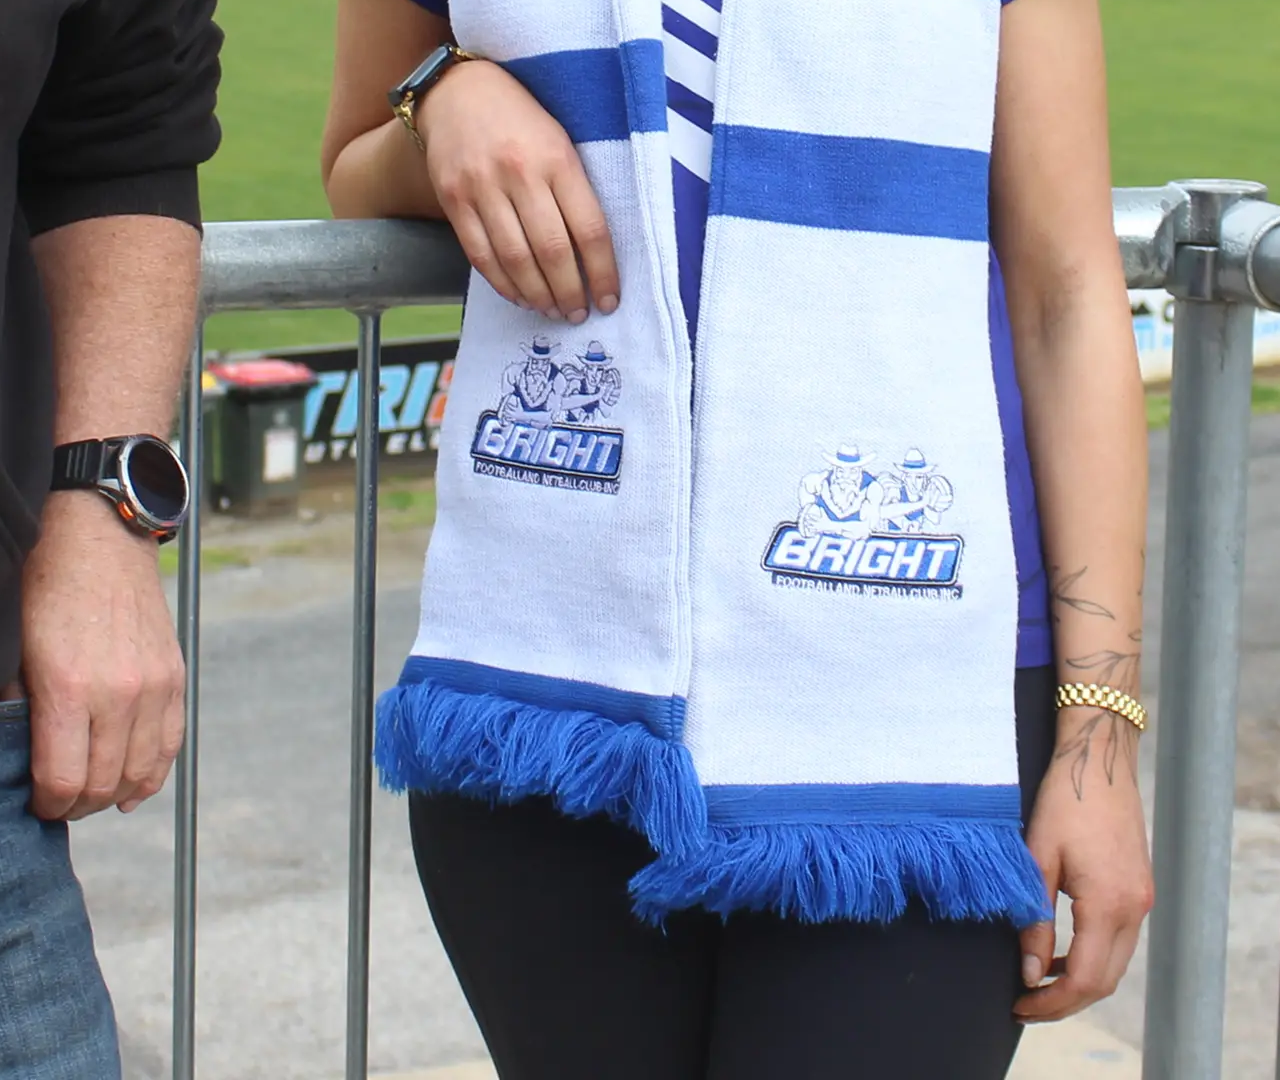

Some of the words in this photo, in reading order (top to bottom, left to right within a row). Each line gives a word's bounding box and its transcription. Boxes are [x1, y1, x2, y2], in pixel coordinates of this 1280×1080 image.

[477, 419, 620, 472] BRIGHT
[475, 461, 523, 480] FOOTBALL
[542, 473, 577, 490] NETBALL
[579, 479, 602, 492] CLUB
[602, 483, 619, 495] INC
[772, 529, 956, 580] BRIGHT
[776, 575, 832, 594] FOOTBALL
[832, 582, 860, 594] AND
[862, 584, 907, 598] NETBALL
[910, 587, 938, 600] CLUB
[939, 588, 960, 601] INC
